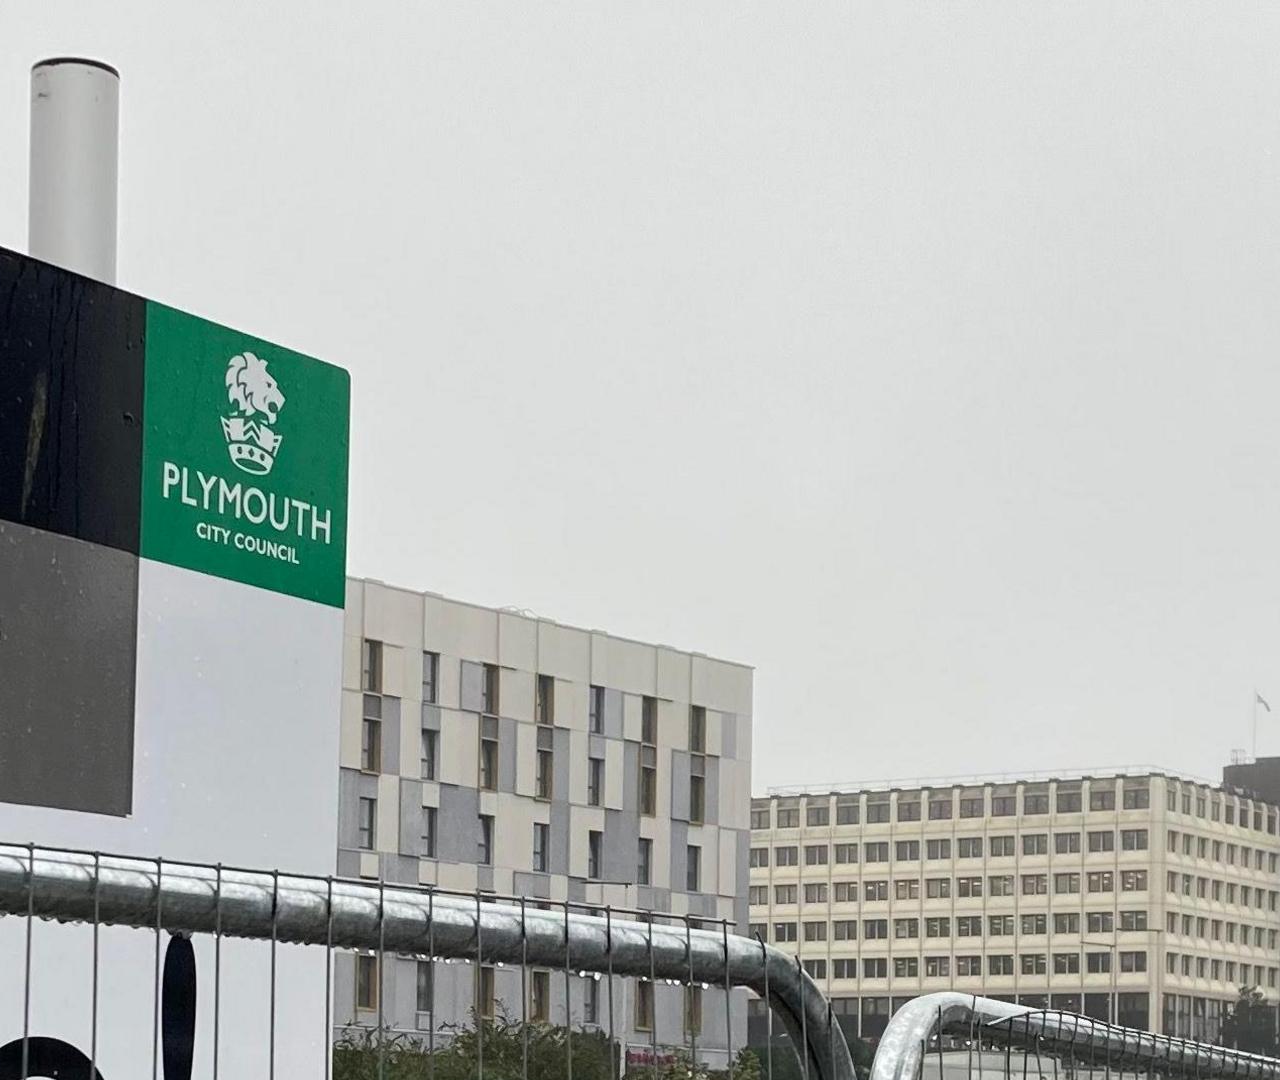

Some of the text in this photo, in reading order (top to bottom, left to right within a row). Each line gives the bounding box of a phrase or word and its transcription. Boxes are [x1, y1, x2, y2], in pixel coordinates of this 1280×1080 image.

[162, 461, 332, 544] PLYMOUTH
[196, 522, 300, 565] CITY COUNCIL
